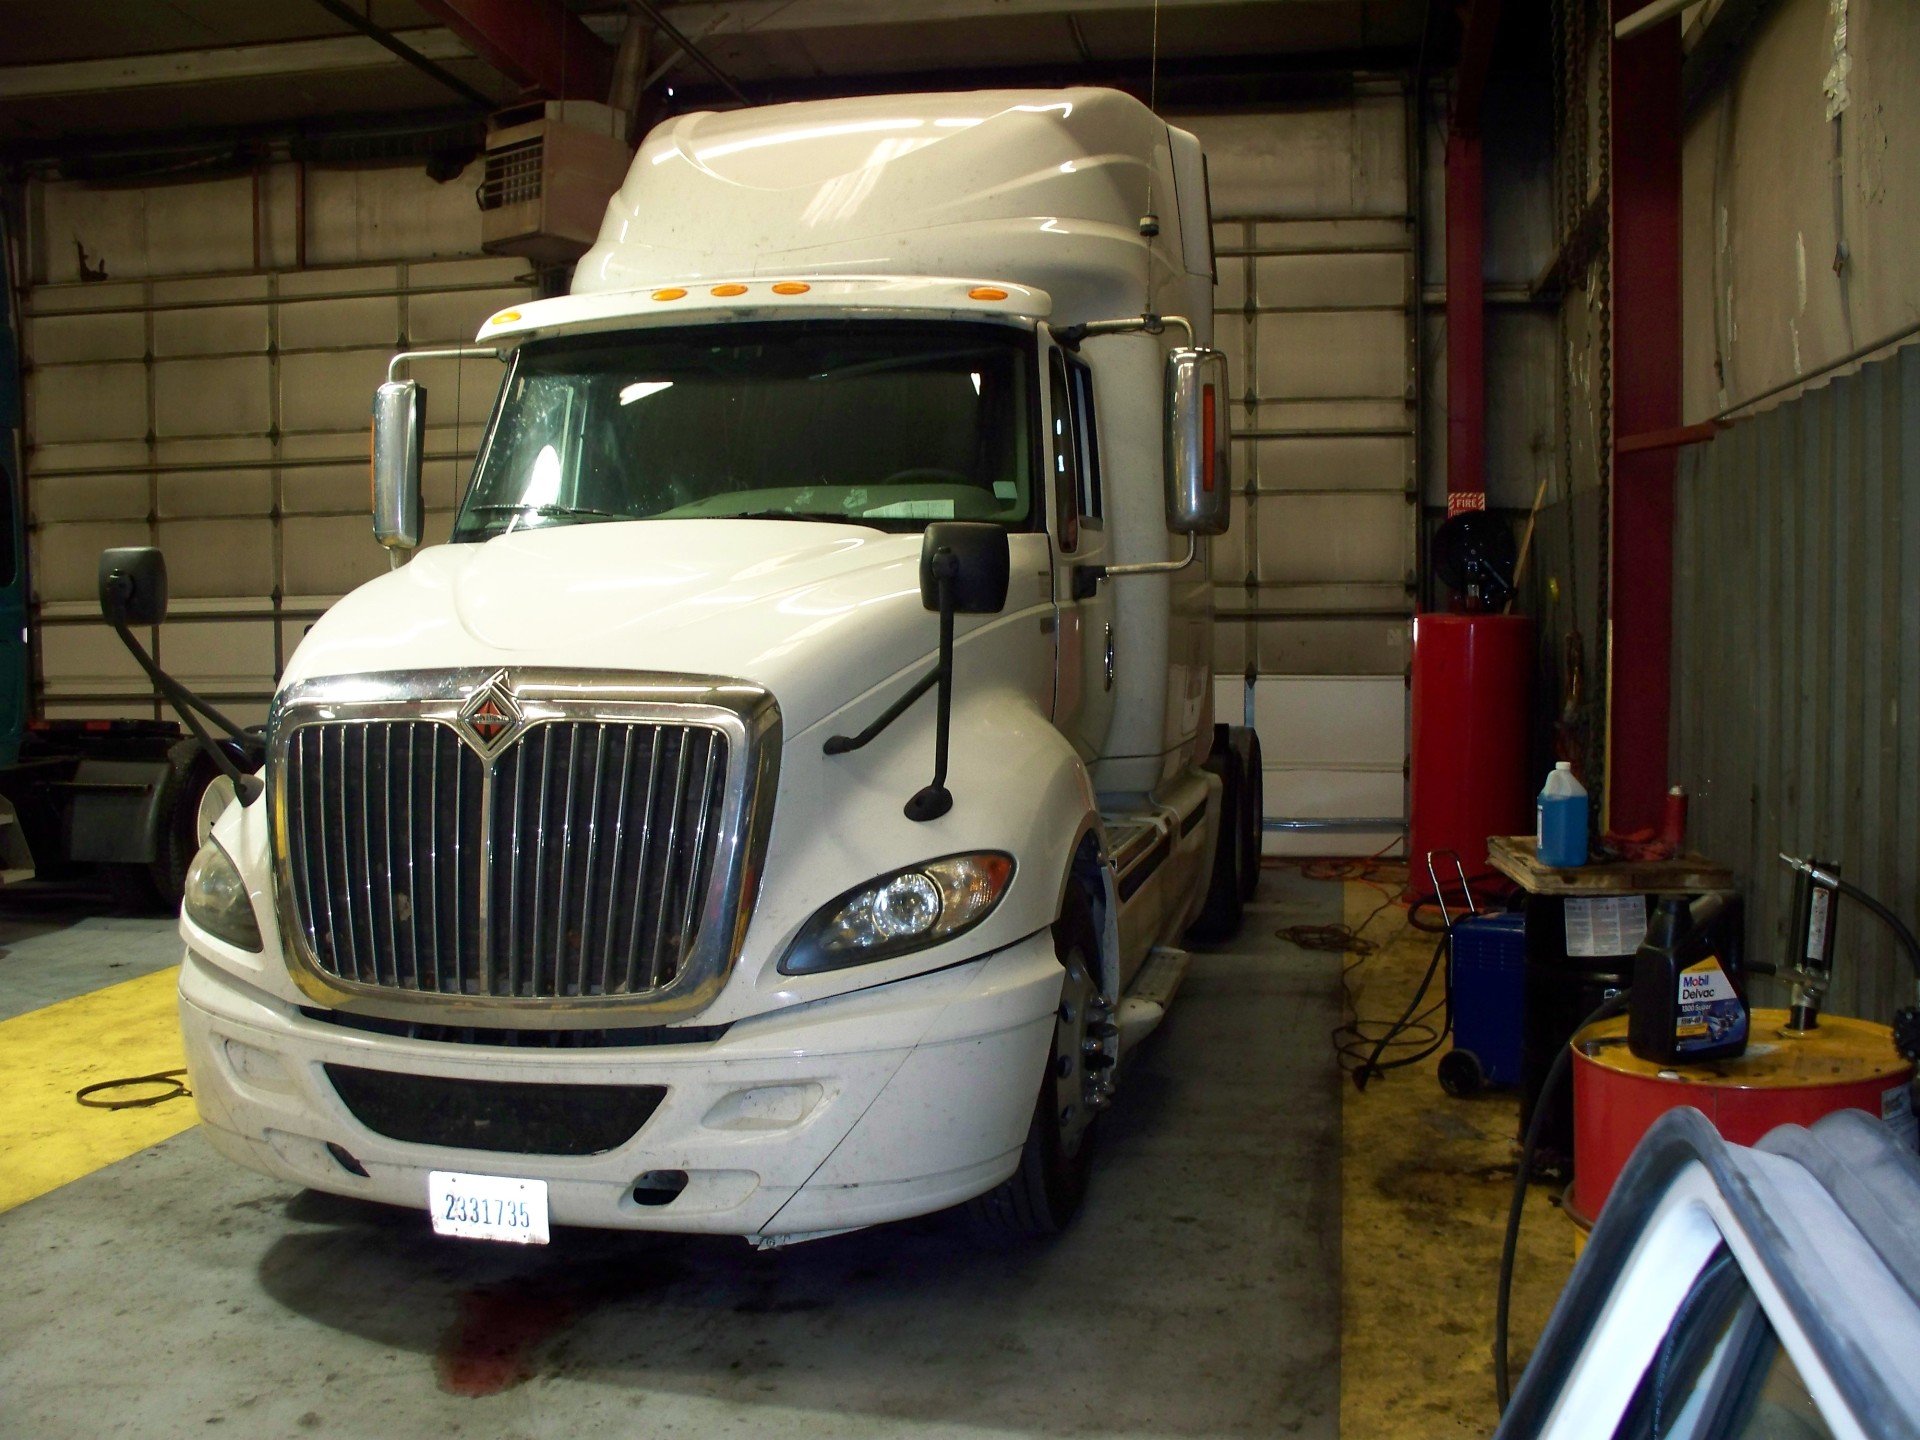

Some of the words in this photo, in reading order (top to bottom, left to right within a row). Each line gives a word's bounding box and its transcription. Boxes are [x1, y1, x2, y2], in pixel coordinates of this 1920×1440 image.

[1456, 499, 1477, 508] FIRE
[1683, 974, 1709, 988] Mobil
[1682, 988, 1715, 1000] Delvac
[445, 1194, 530, 1228] 2331735
